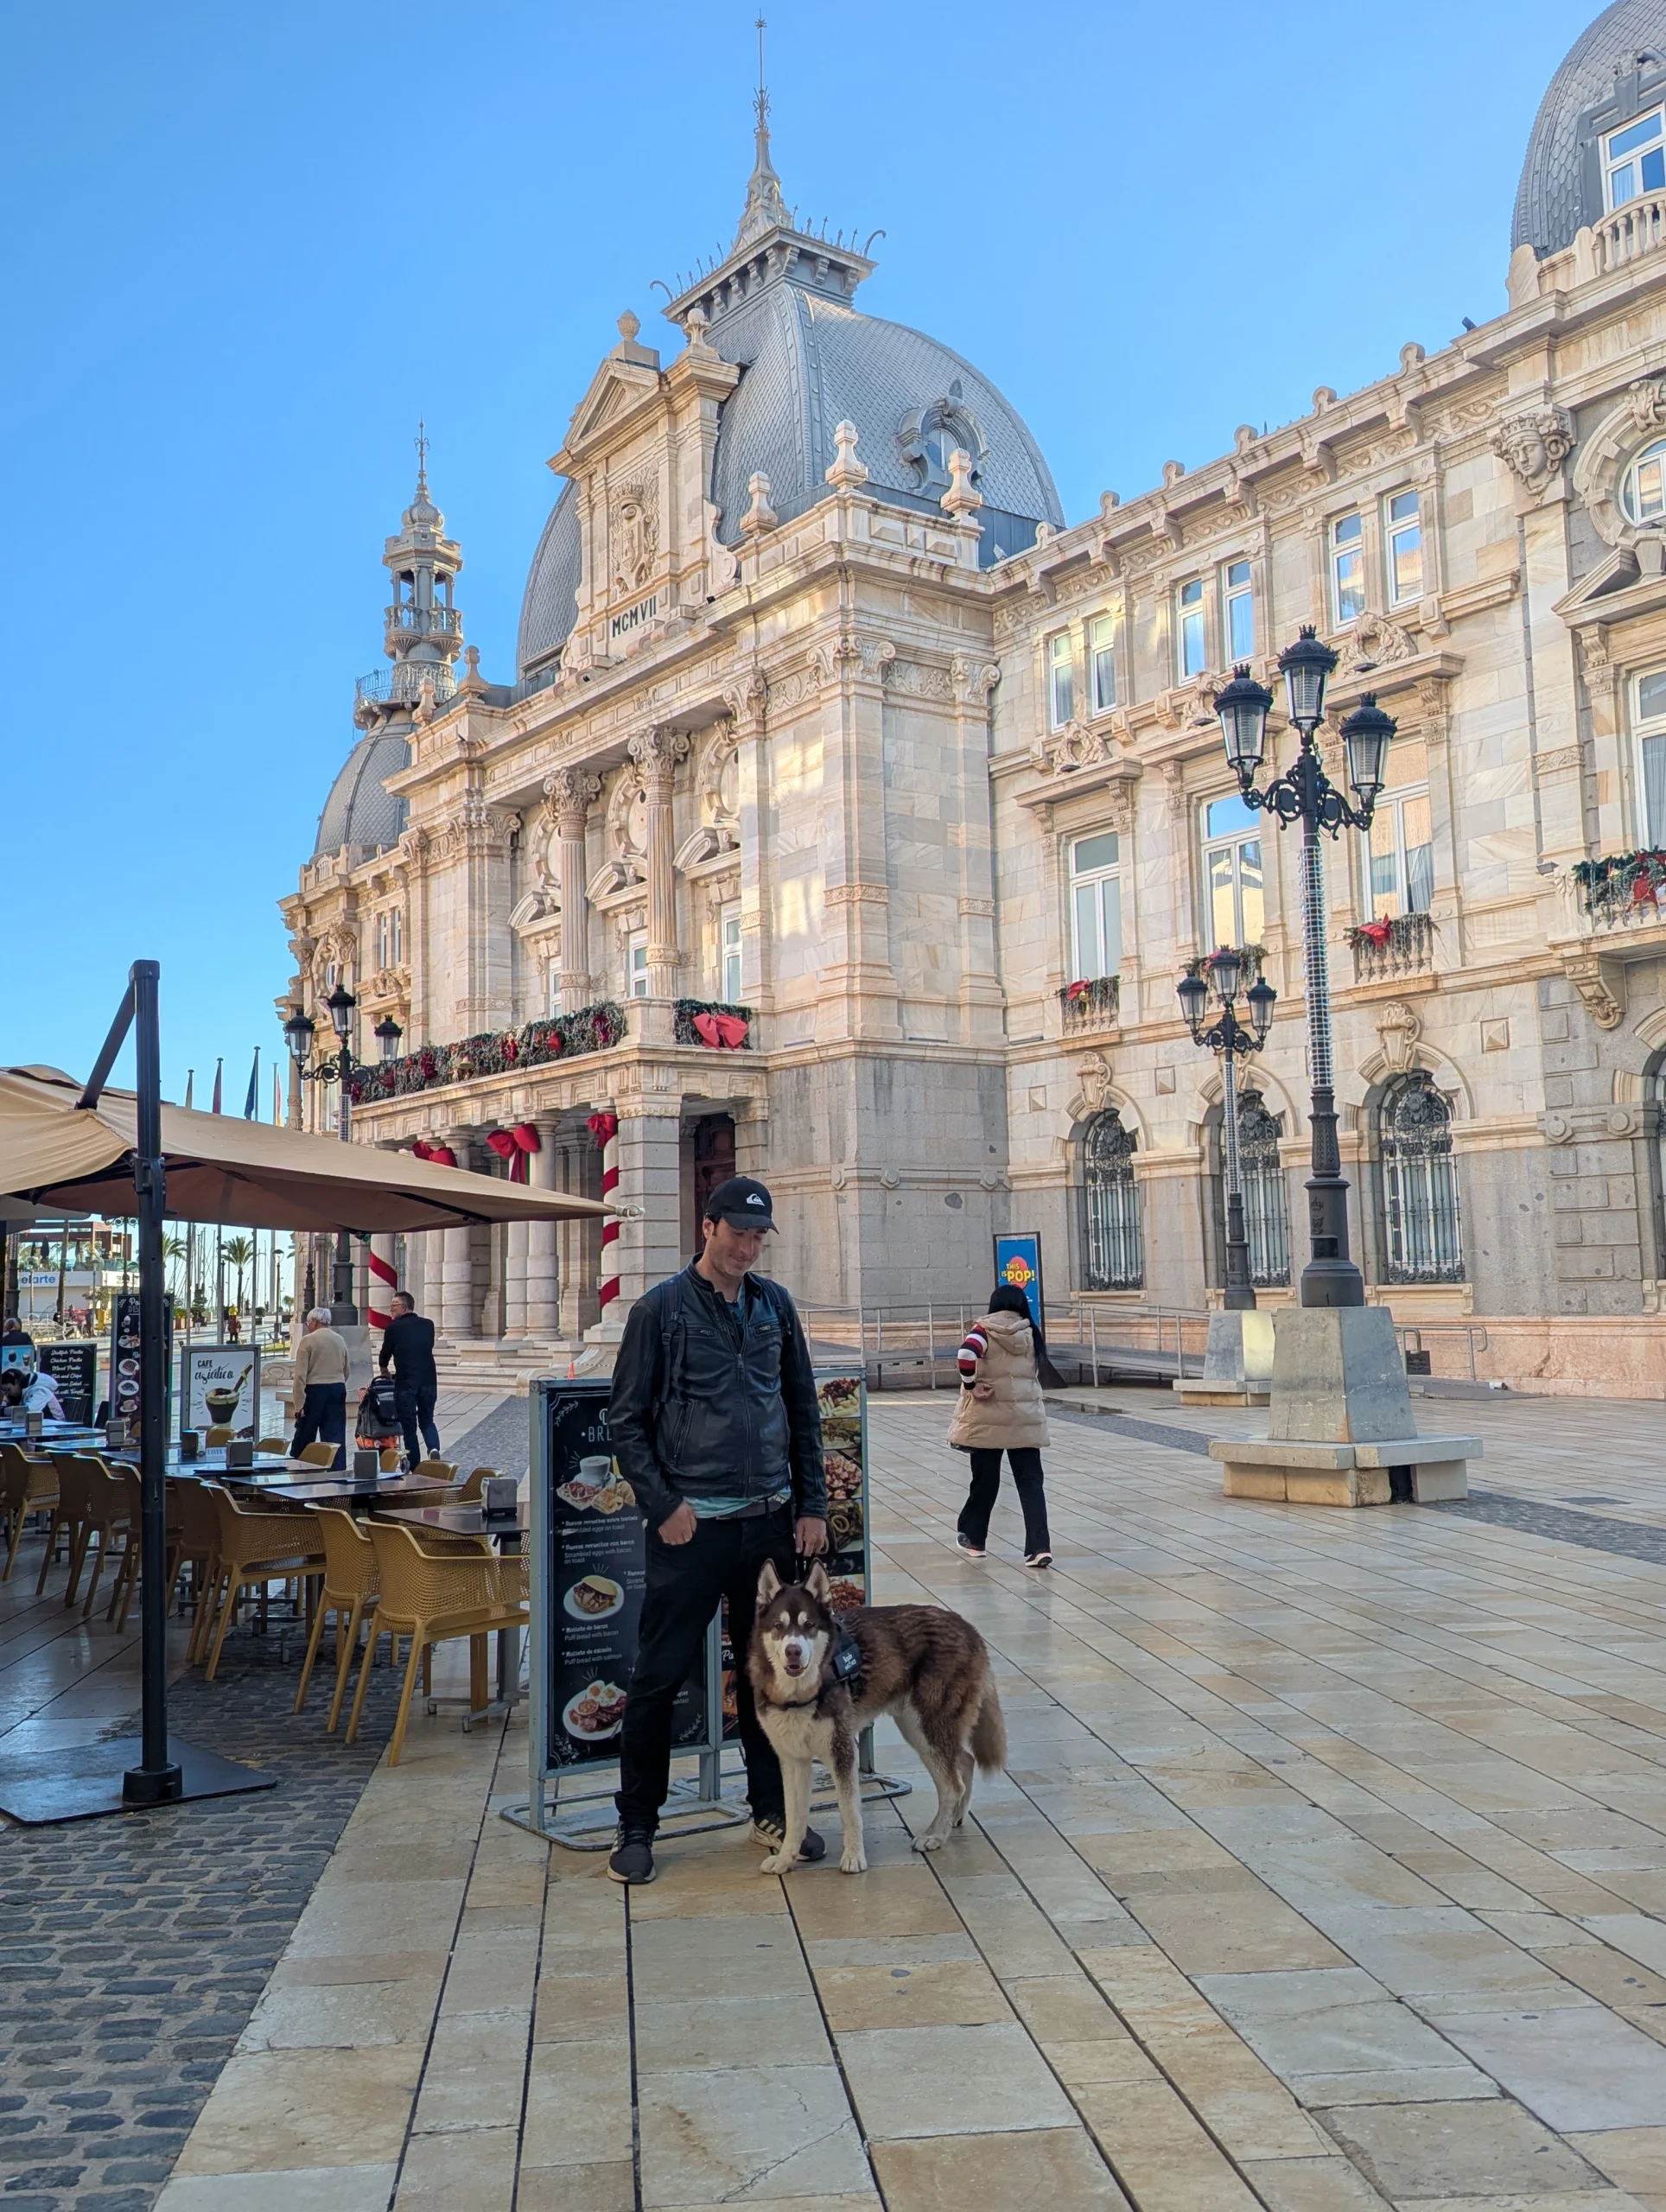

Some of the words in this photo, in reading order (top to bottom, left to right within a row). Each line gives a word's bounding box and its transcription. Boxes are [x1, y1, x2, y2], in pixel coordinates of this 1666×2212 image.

[612, 595, 657, 638] MCMVII
[1008, 1270, 1035, 1282] POP!
[564, 1550, 591, 1559] Scrambled
